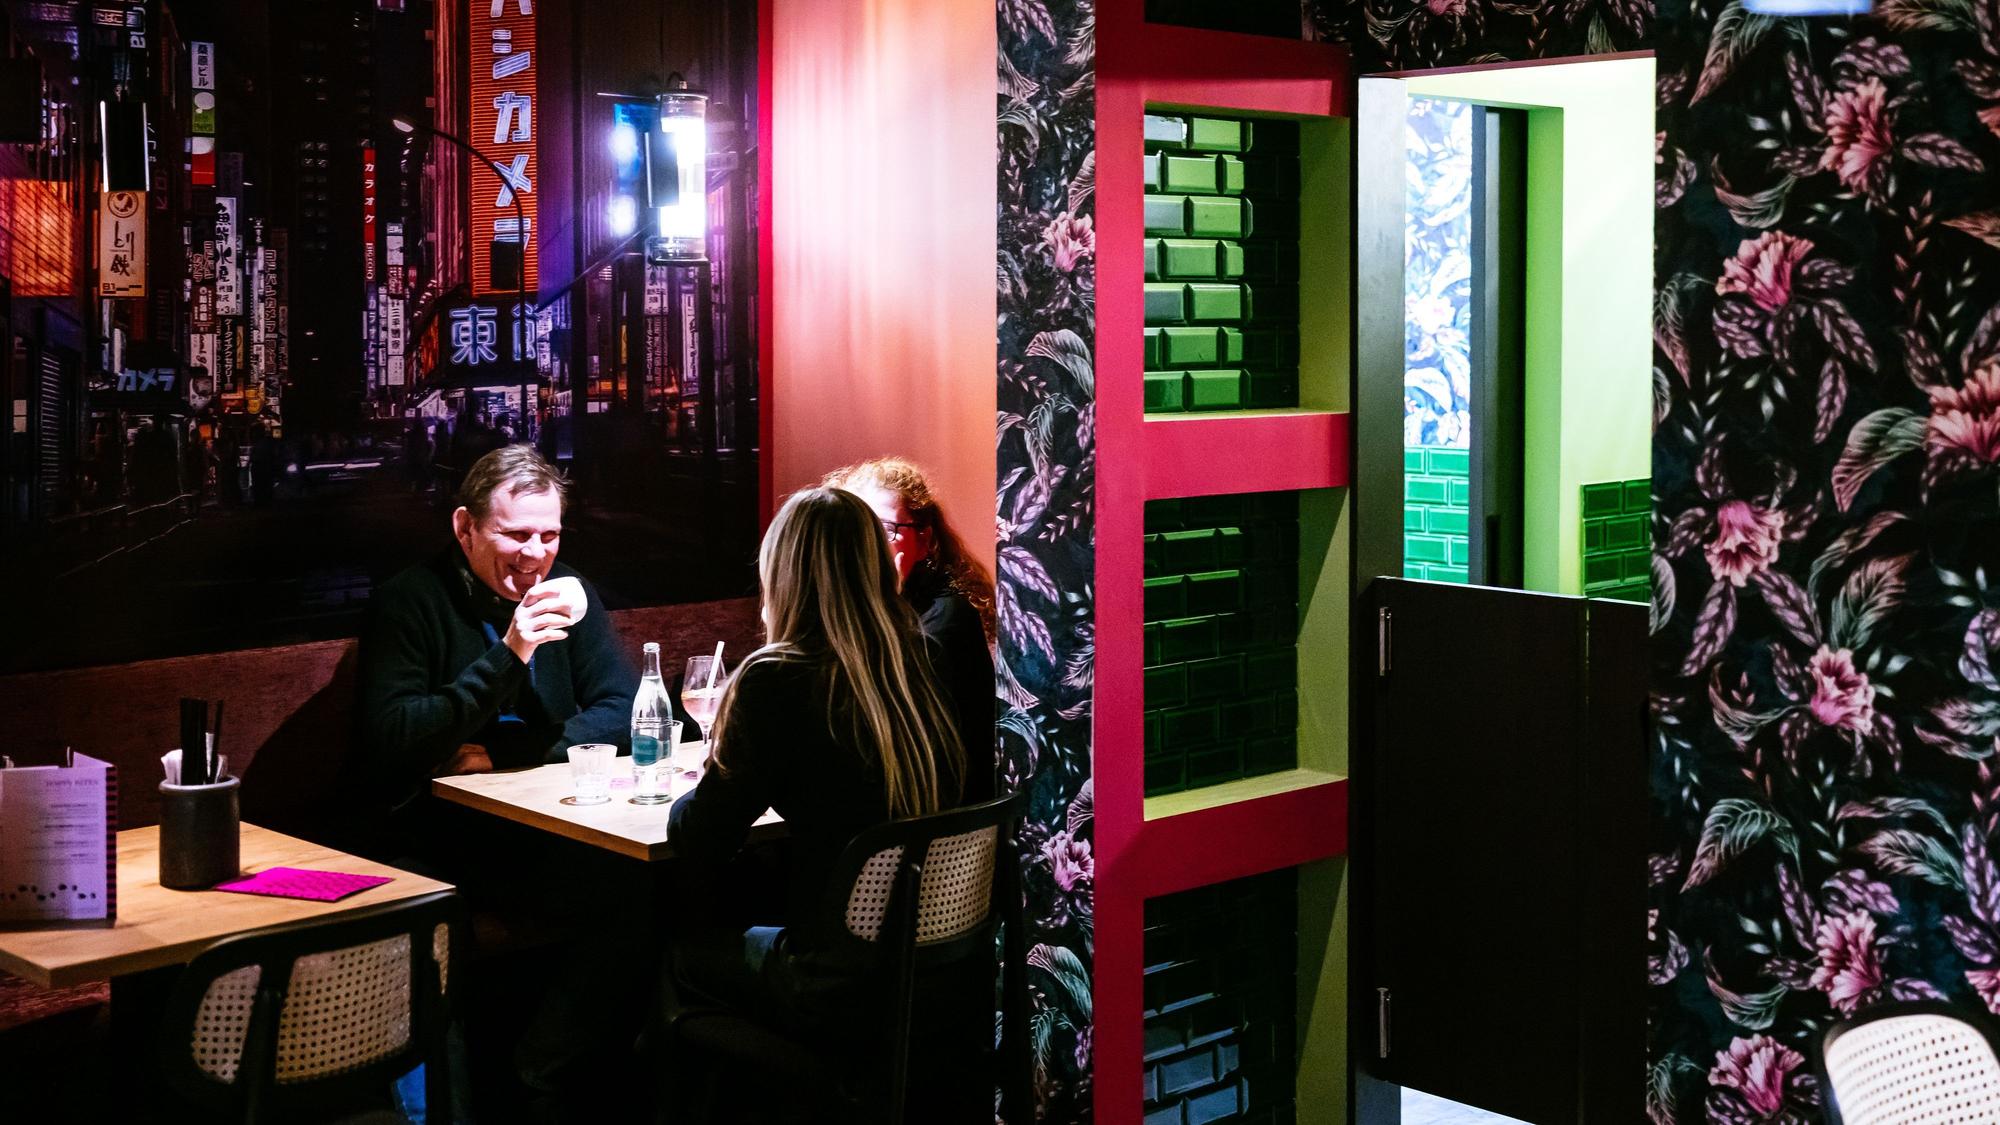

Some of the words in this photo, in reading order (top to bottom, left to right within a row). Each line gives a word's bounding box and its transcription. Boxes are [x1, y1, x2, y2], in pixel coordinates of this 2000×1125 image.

[365, 163, 375, 223] カラオケ
[117, 368, 176, 392] カメラ
